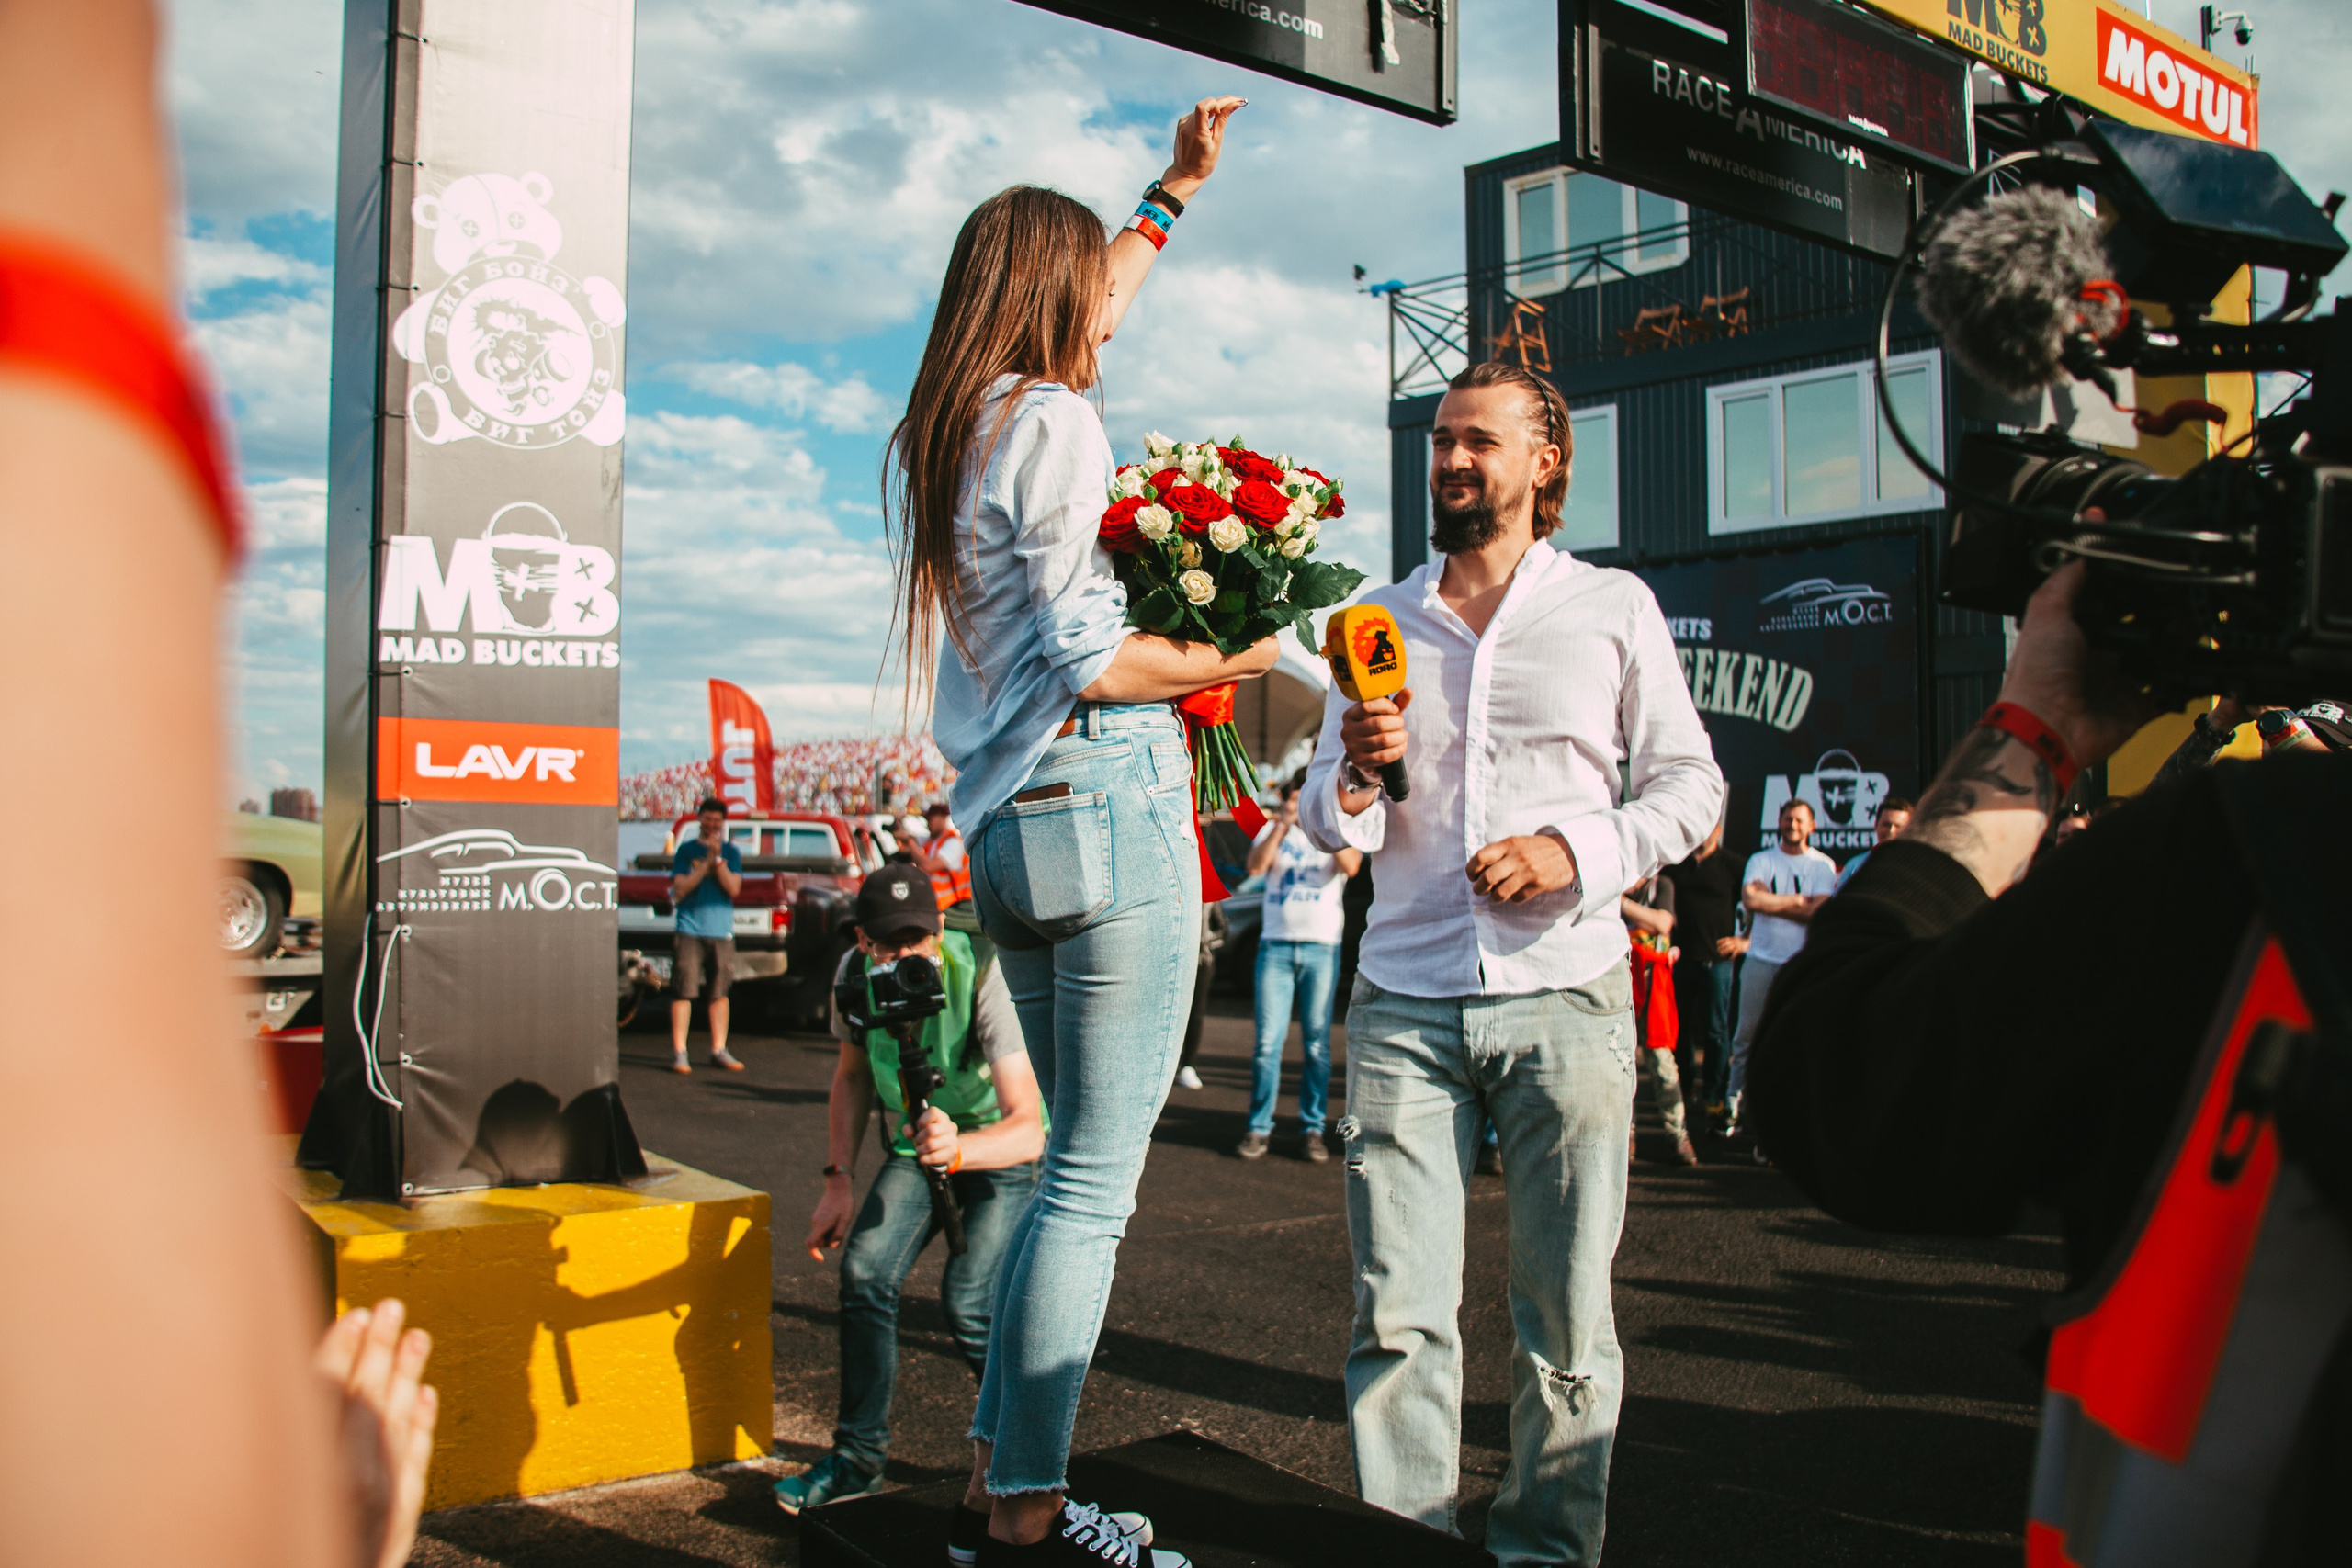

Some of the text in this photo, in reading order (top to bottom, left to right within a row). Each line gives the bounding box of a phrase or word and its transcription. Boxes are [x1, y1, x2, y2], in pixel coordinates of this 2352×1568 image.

[1948, 20, 2049, 84] MAD BUCKETS
[2104, 27, 2248, 146] MOTUL
[1686, 146, 1843, 211] www.raceamerica.com
[430, 275, 471, 337] БИГ
[464, 367, 613, 444] БИГ ТОЙЗ
[379, 637, 621, 668] MAD BUCKETS
[1666, 617, 1712, 640] KETS
[1675, 647, 1813, 732] EEKEND
[415, 742, 577, 782] LAVR
[1808, 830, 1879, 849] BUCKET
